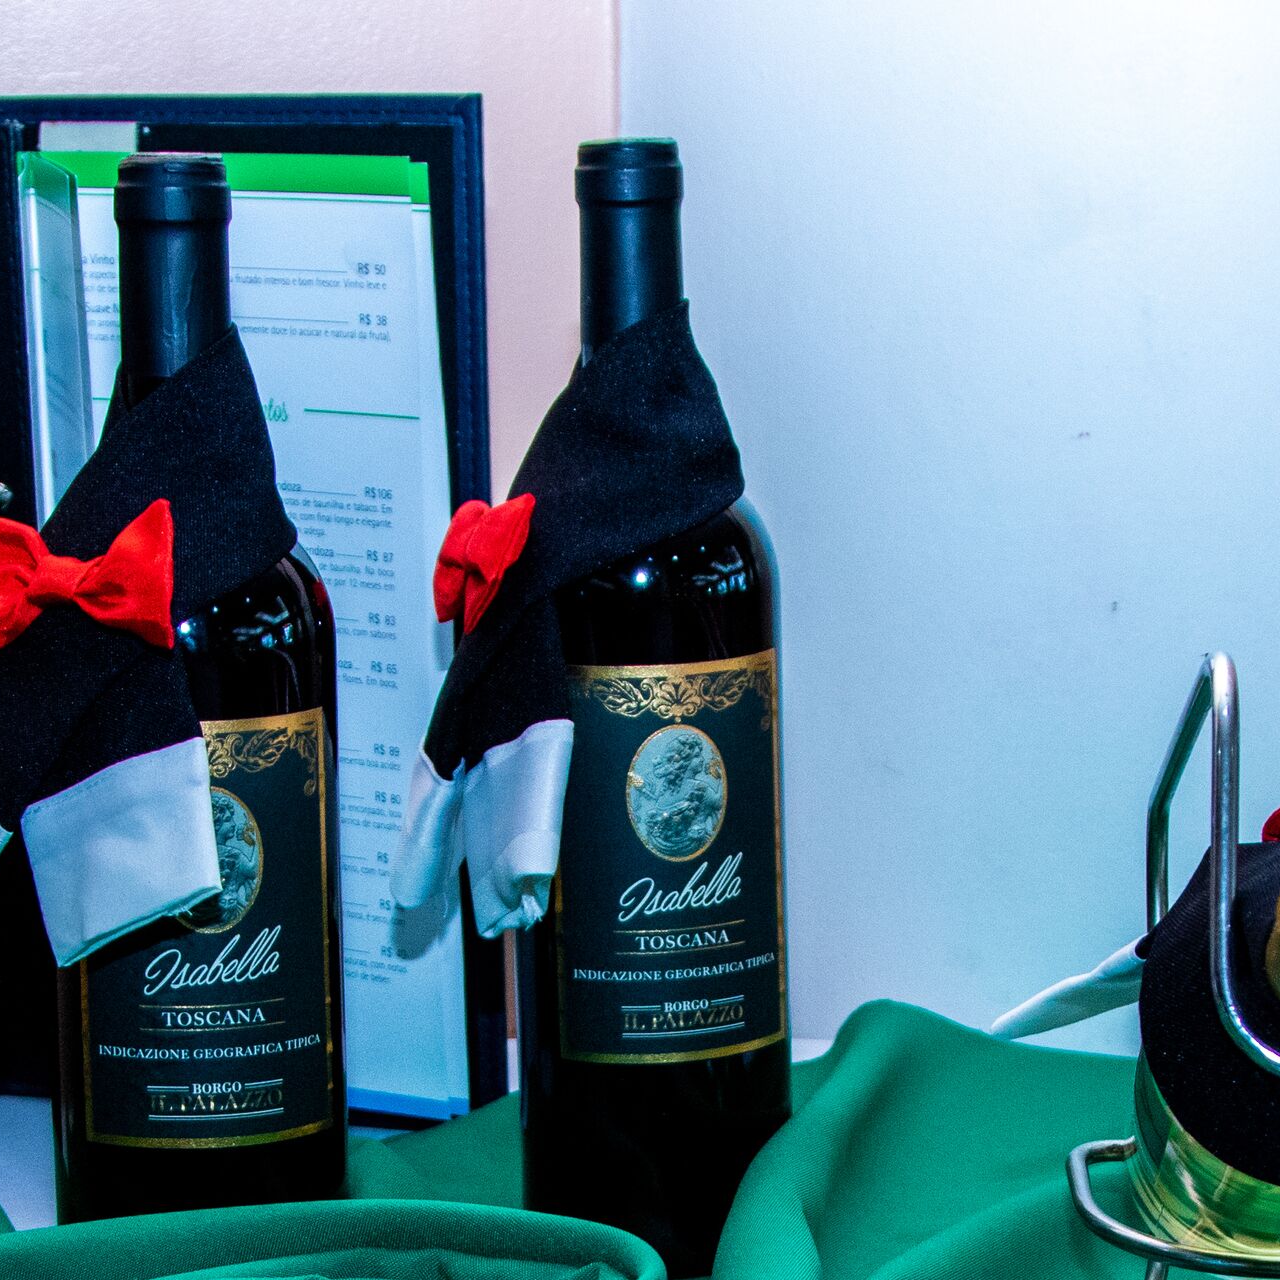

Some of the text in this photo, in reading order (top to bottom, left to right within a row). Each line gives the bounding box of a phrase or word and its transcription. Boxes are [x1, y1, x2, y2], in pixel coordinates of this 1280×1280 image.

[357, 262, 387, 276] R$ 50
[618, 851, 744, 923] Isabella
[635, 929, 730, 951] TOSCANA
[143, 924, 282, 998] Isabella
[573, 952, 776, 982] INDICAZIONE GEOGRAFICA TIPICA
[664, 998, 709, 1013] BORGO
[161, 1007, 267, 1029] TOSCANA
[98, 1032, 322, 1061] INDICAZIONE GEOGRAFICA TIPICA
[192, 1080, 243, 1095] BORGO
